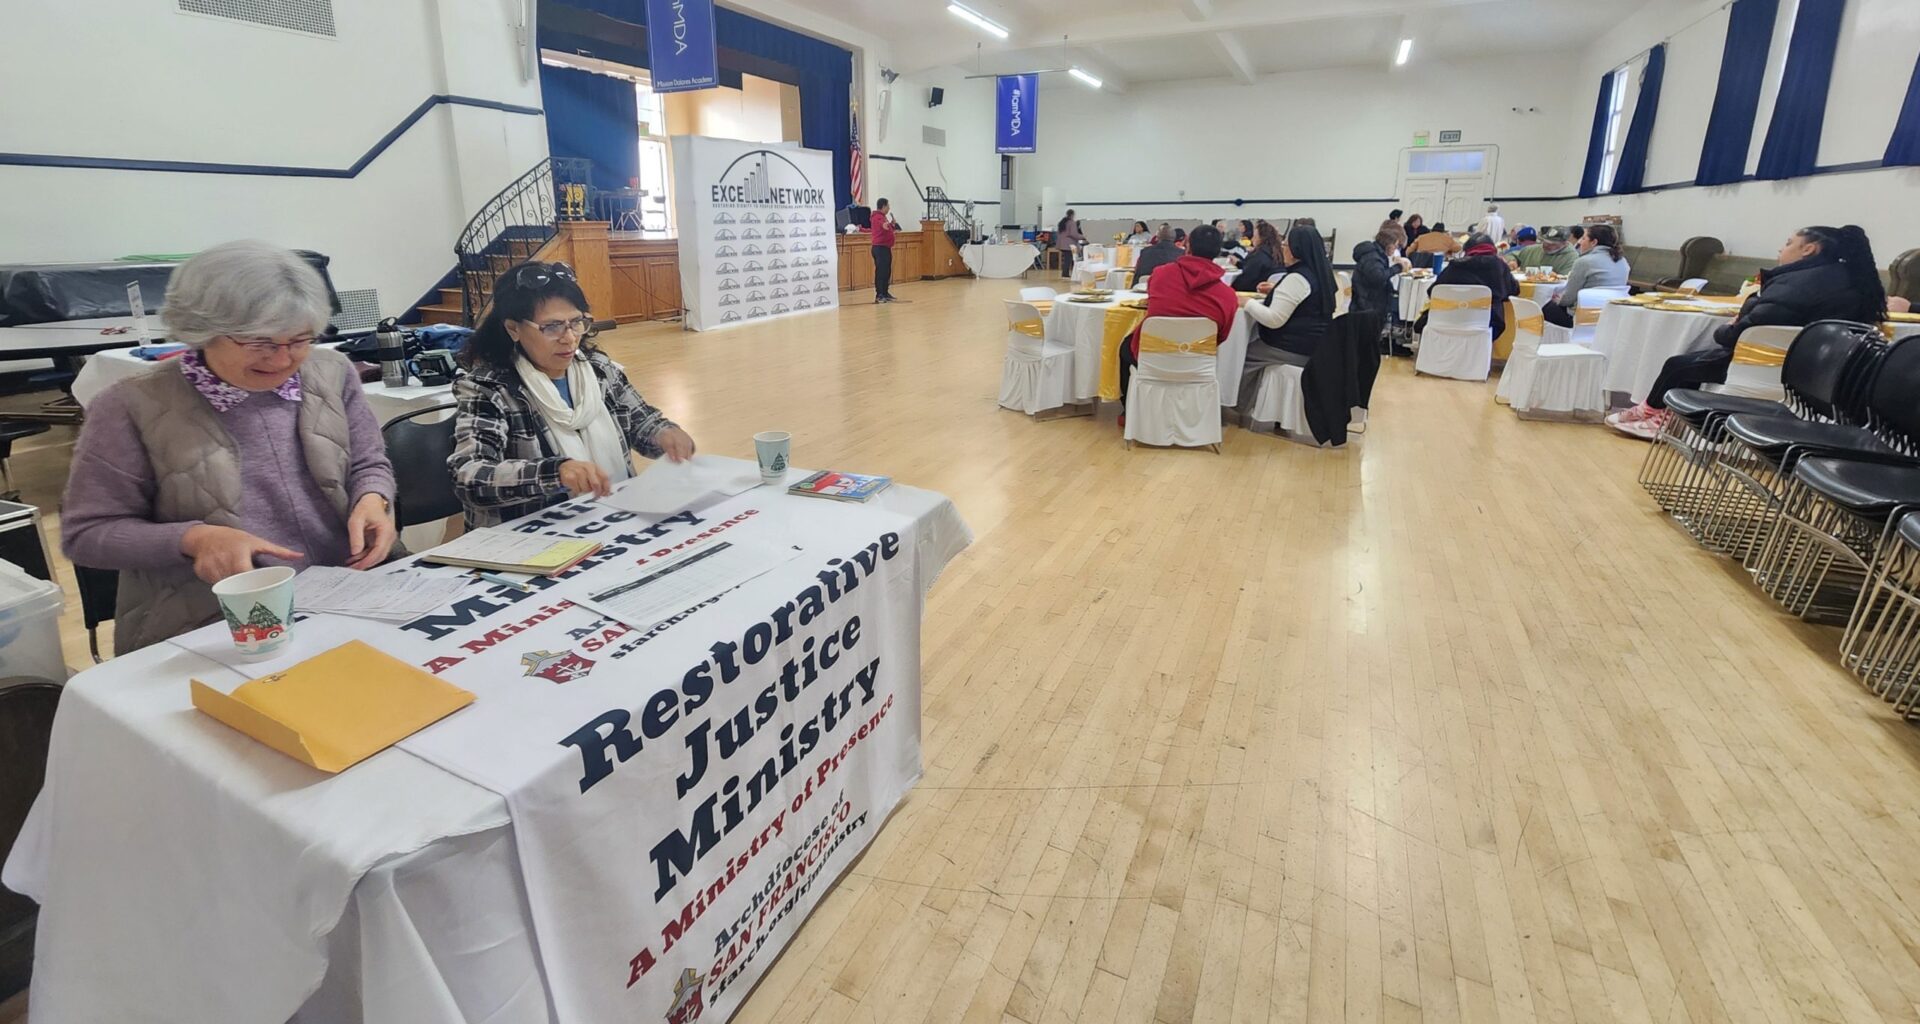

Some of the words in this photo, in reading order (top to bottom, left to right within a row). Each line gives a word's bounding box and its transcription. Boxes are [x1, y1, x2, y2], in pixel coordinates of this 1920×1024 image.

[769, 187, 825, 205] NETWORK
[422, 655, 466, 675] A
[558, 532, 899, 795] Restorative
[676, 615, 861, 801] Justice
[627, 946, 657, 989] A
[661, 809, 786, 954] Ministry
[792, 776, 812, 813] of
[817, 693, 893, 788] Presence
[650, 656, 880, 904] Ministry
[714, 815, 828, 958] Archdiocese
[831, 788, 844, 814] of
[708, 920, 753, 988] SAN
[757, 801, 850, 931] FRANCISCO
